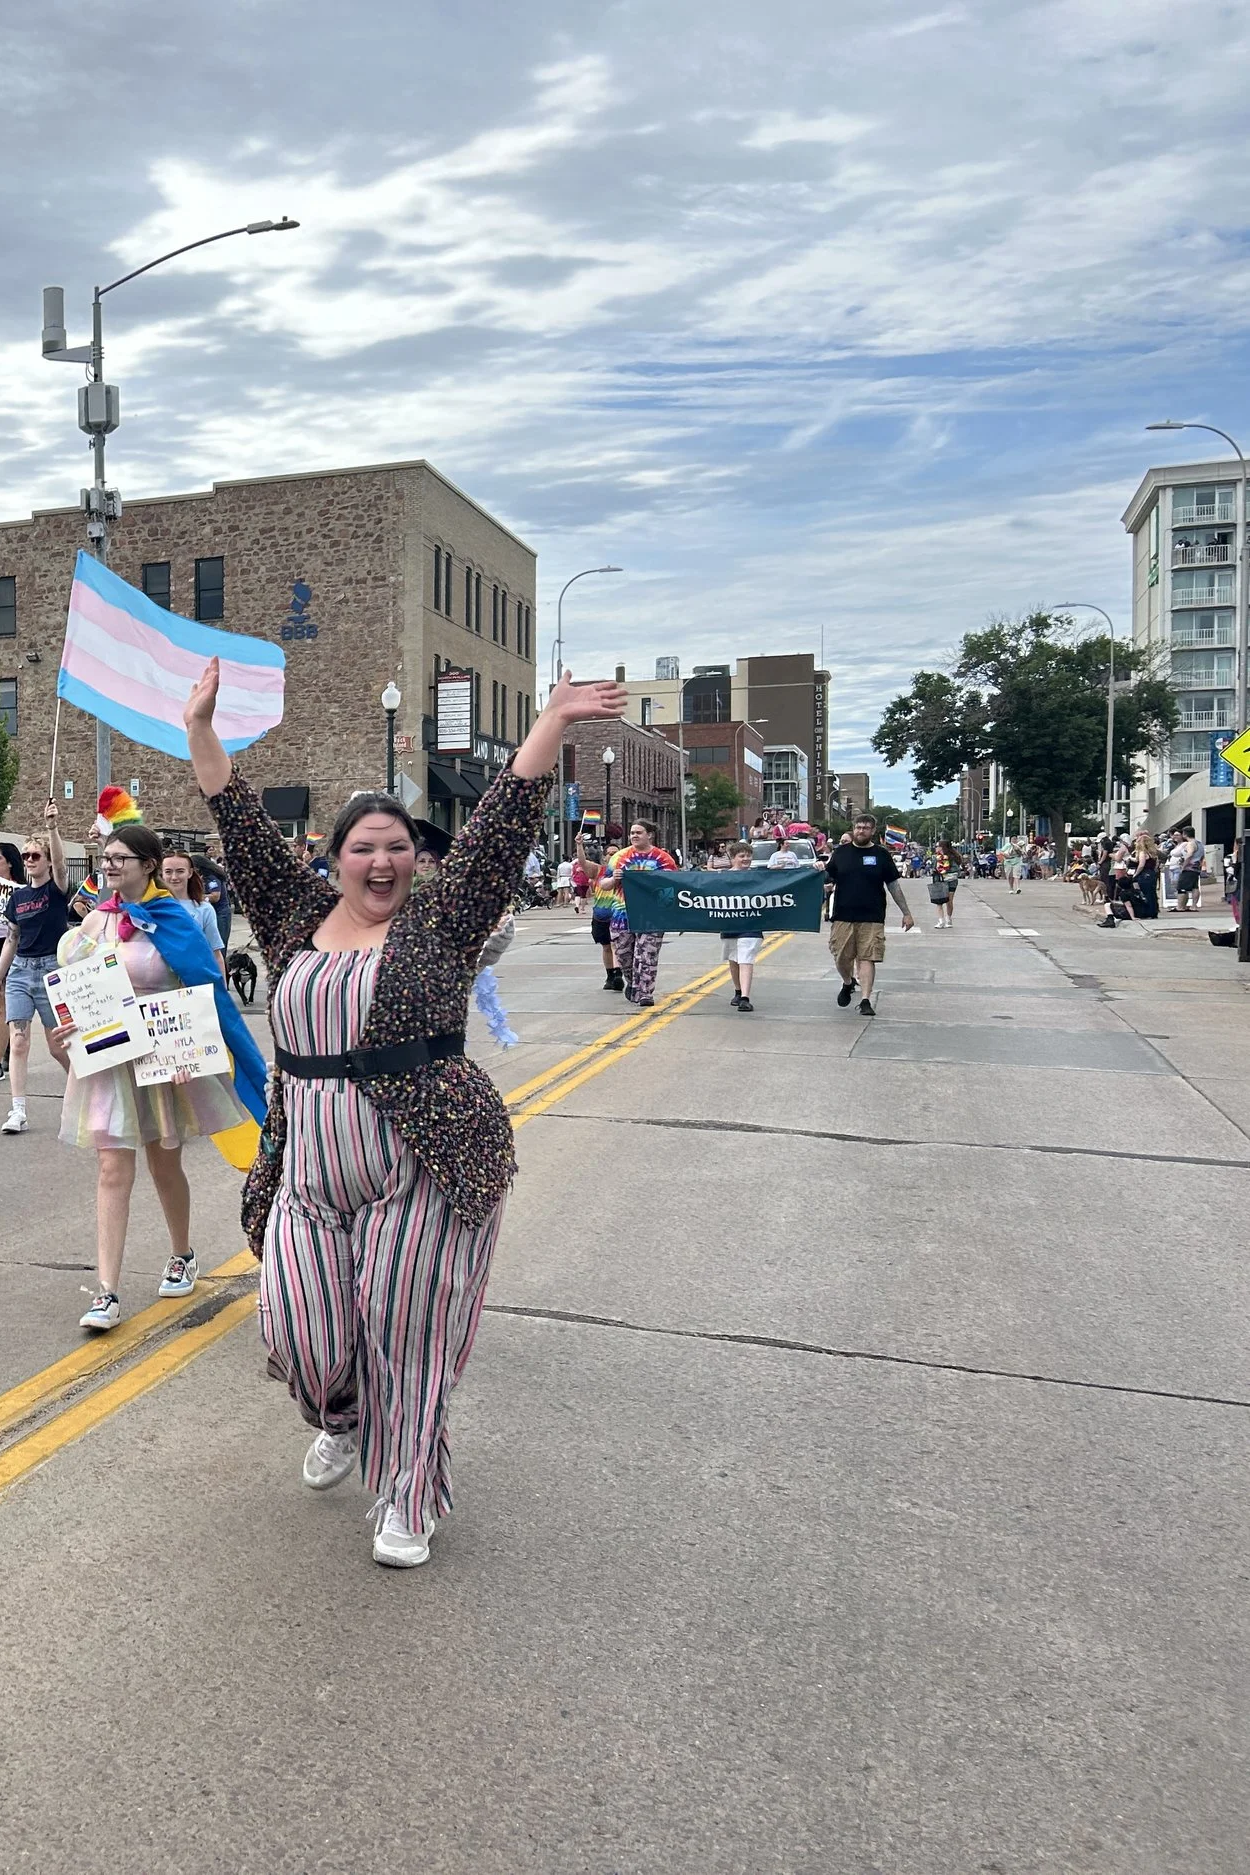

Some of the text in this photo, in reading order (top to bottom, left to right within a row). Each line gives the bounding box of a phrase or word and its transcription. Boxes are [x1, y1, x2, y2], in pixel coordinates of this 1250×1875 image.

[281, 624, 319, 640] BBB
[815, 685, 823, 725] HOTEL
[815, 735, 823, 801] PHILLIPS
[709, 910, 762, 918] FINANCIAL
[138, 1000, 169, 1021] THE
[146, 1012, 193, 1038] ROOKIE
[174, 1036, 195, 1049] NYLA
[181, 1044, 218, 1061] CHENFORD
